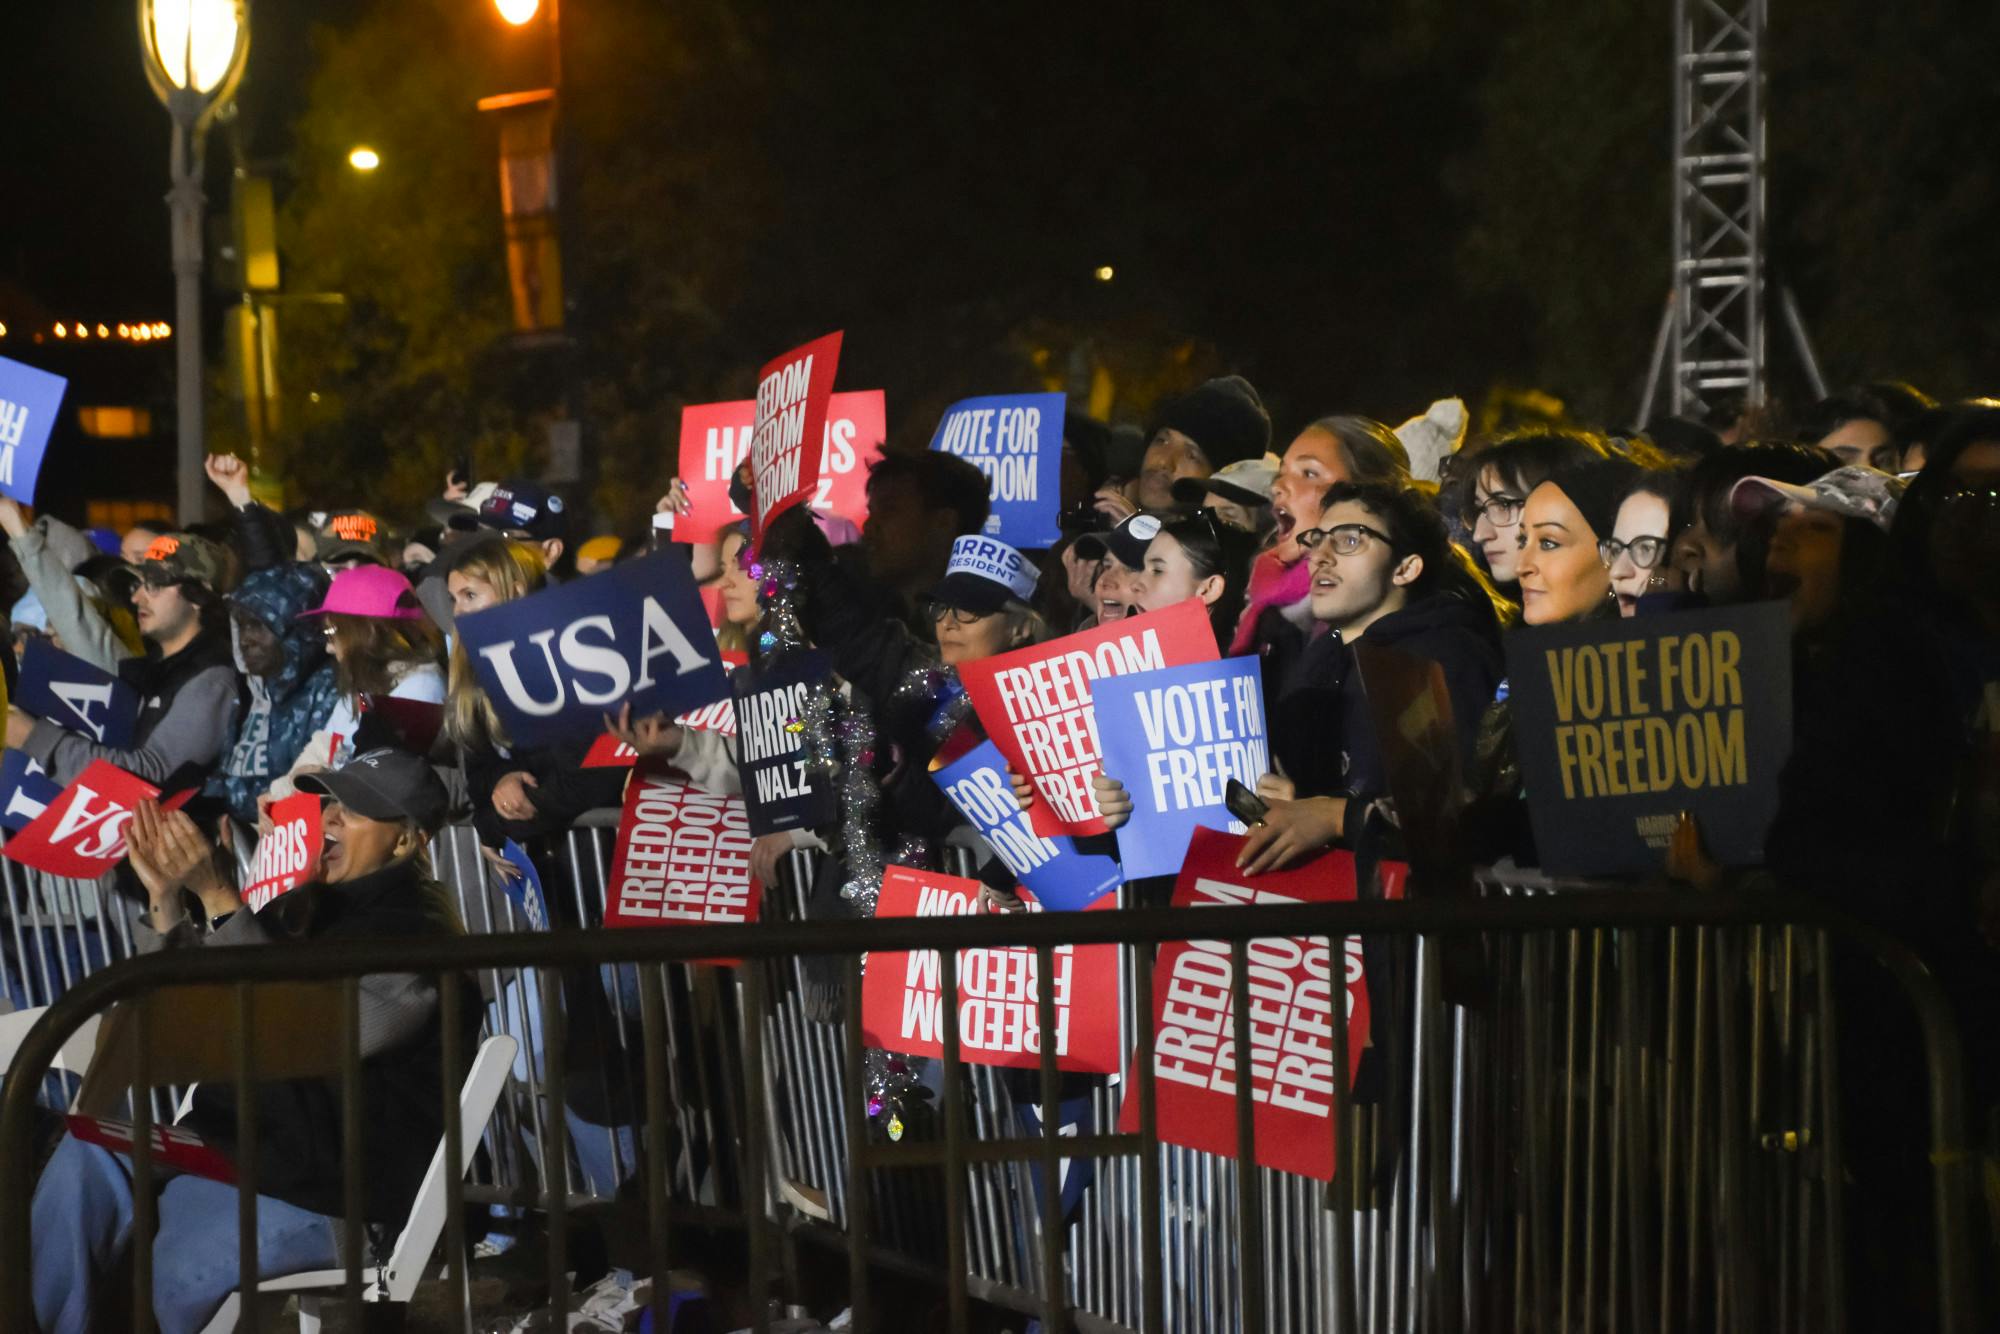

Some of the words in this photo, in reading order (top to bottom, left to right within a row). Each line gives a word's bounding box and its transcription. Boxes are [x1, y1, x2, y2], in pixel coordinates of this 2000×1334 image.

[941, 409, 995, 456] VOTE
[996, 407, 1041, 454] FOR
[949, 557, 1016, 582] RESIDENT
[952, 539, 1023, 573] ARRIS
[479, 596, 710, 717] USA
[994, 628, 1167, 723] FREEDOM
[1545, 639, 1650, 722] VOTE
[1657, 630, 1743, 712] FOR
[1013, 705, 1103, 774] FREE
[1134, 680, 1233, 750] VOTE
[755, 760, 812, 803] WALZ
[1554, 709, 1748, 801] FREEDOM
[48, 783, 135, 860] SA
[946, 766, 1022, 832] FOR
[1034, 762, 1106, 823] FREE
[246, 818, 307, 888] ARRIS
[618, 779, 690, 918] FREEDOM
[704, 797, 752, 922] FREEDO
